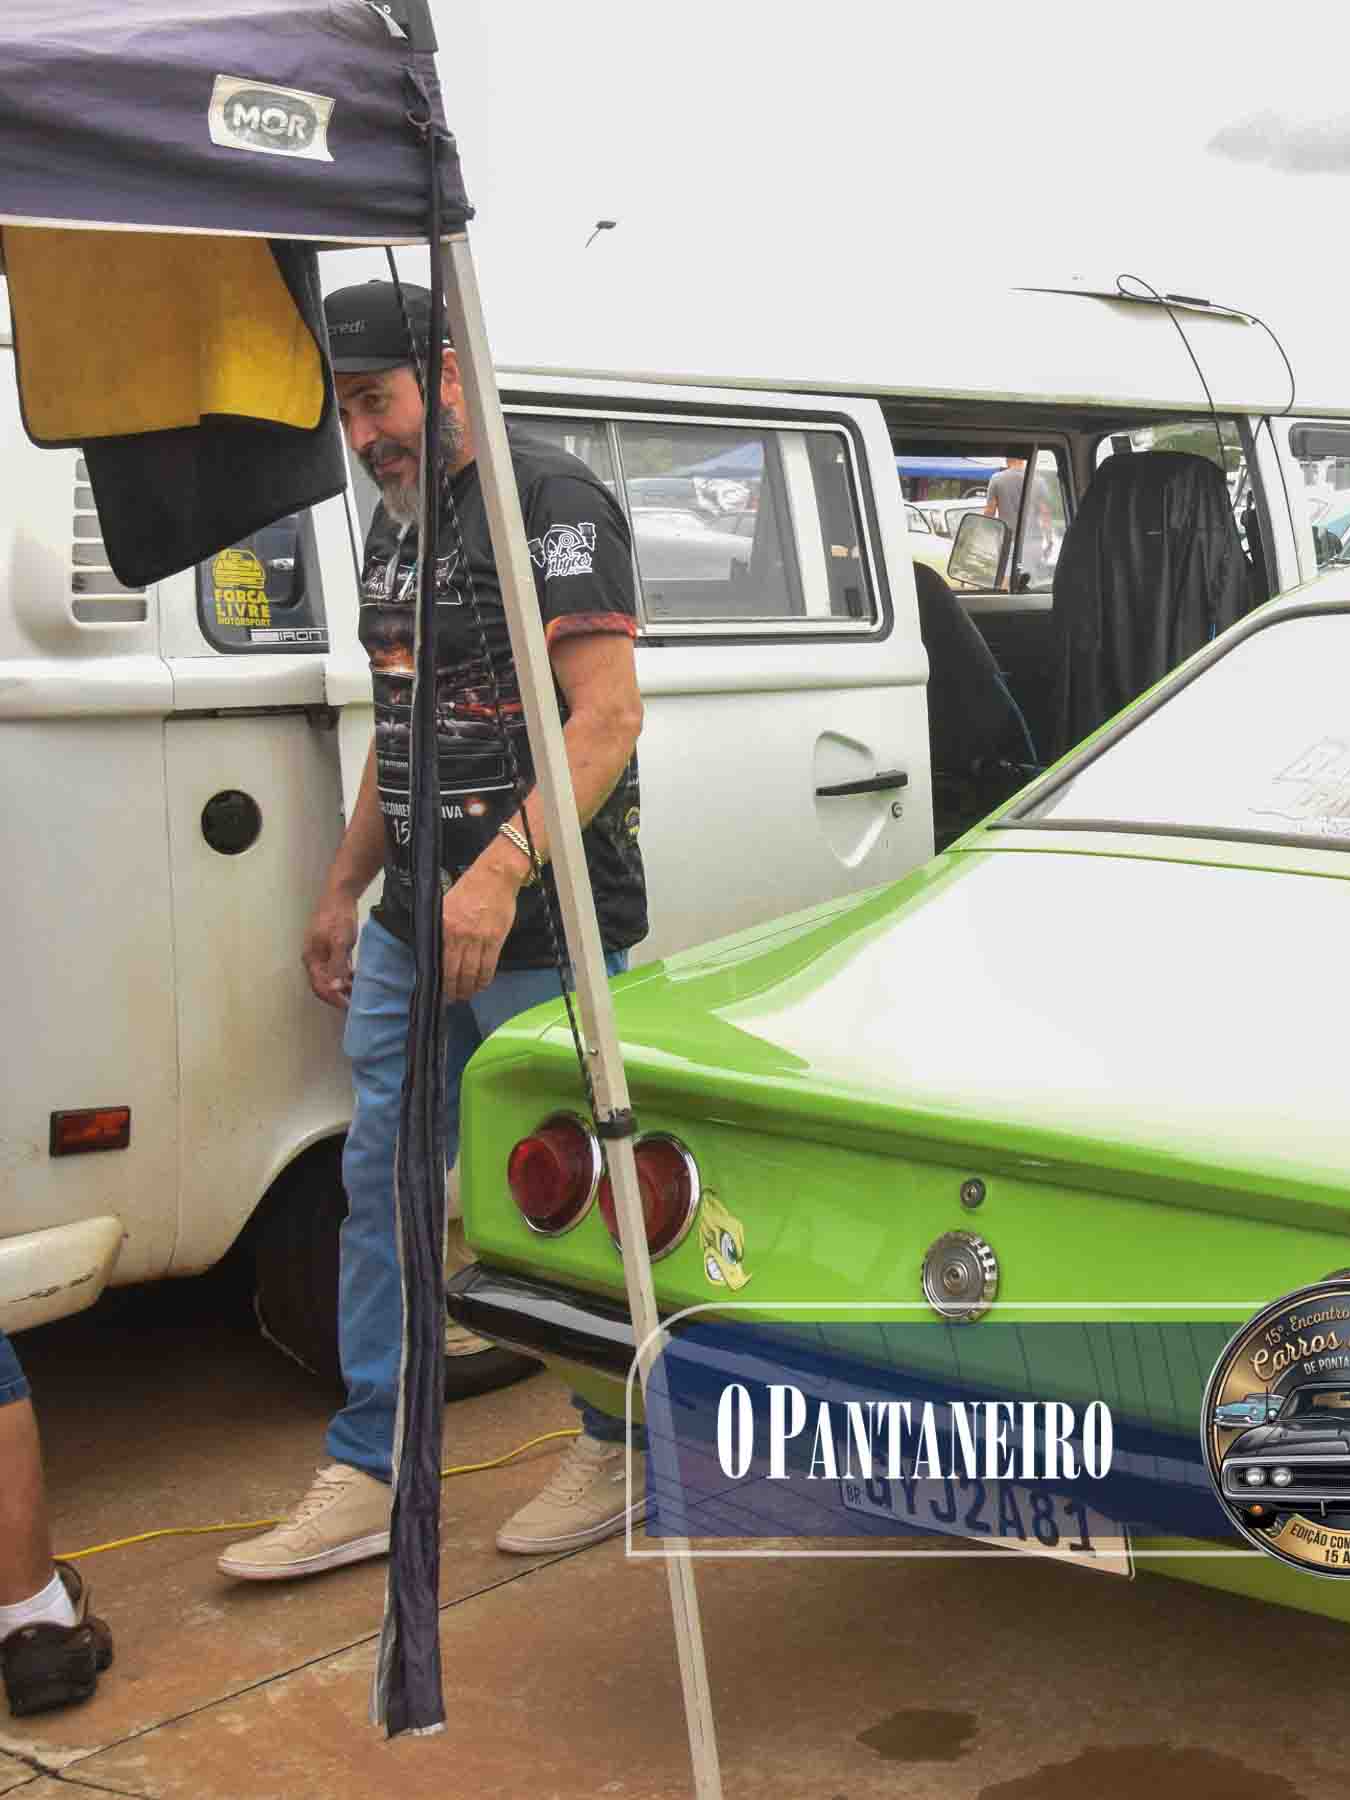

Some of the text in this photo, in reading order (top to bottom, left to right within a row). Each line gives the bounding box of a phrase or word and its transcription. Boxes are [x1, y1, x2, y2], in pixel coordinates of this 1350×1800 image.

[233, 103, 306, 139] MOR
[216, 603, 270, 618] LIVRE
[217, 617, 271, 627] MOTORSPORT
